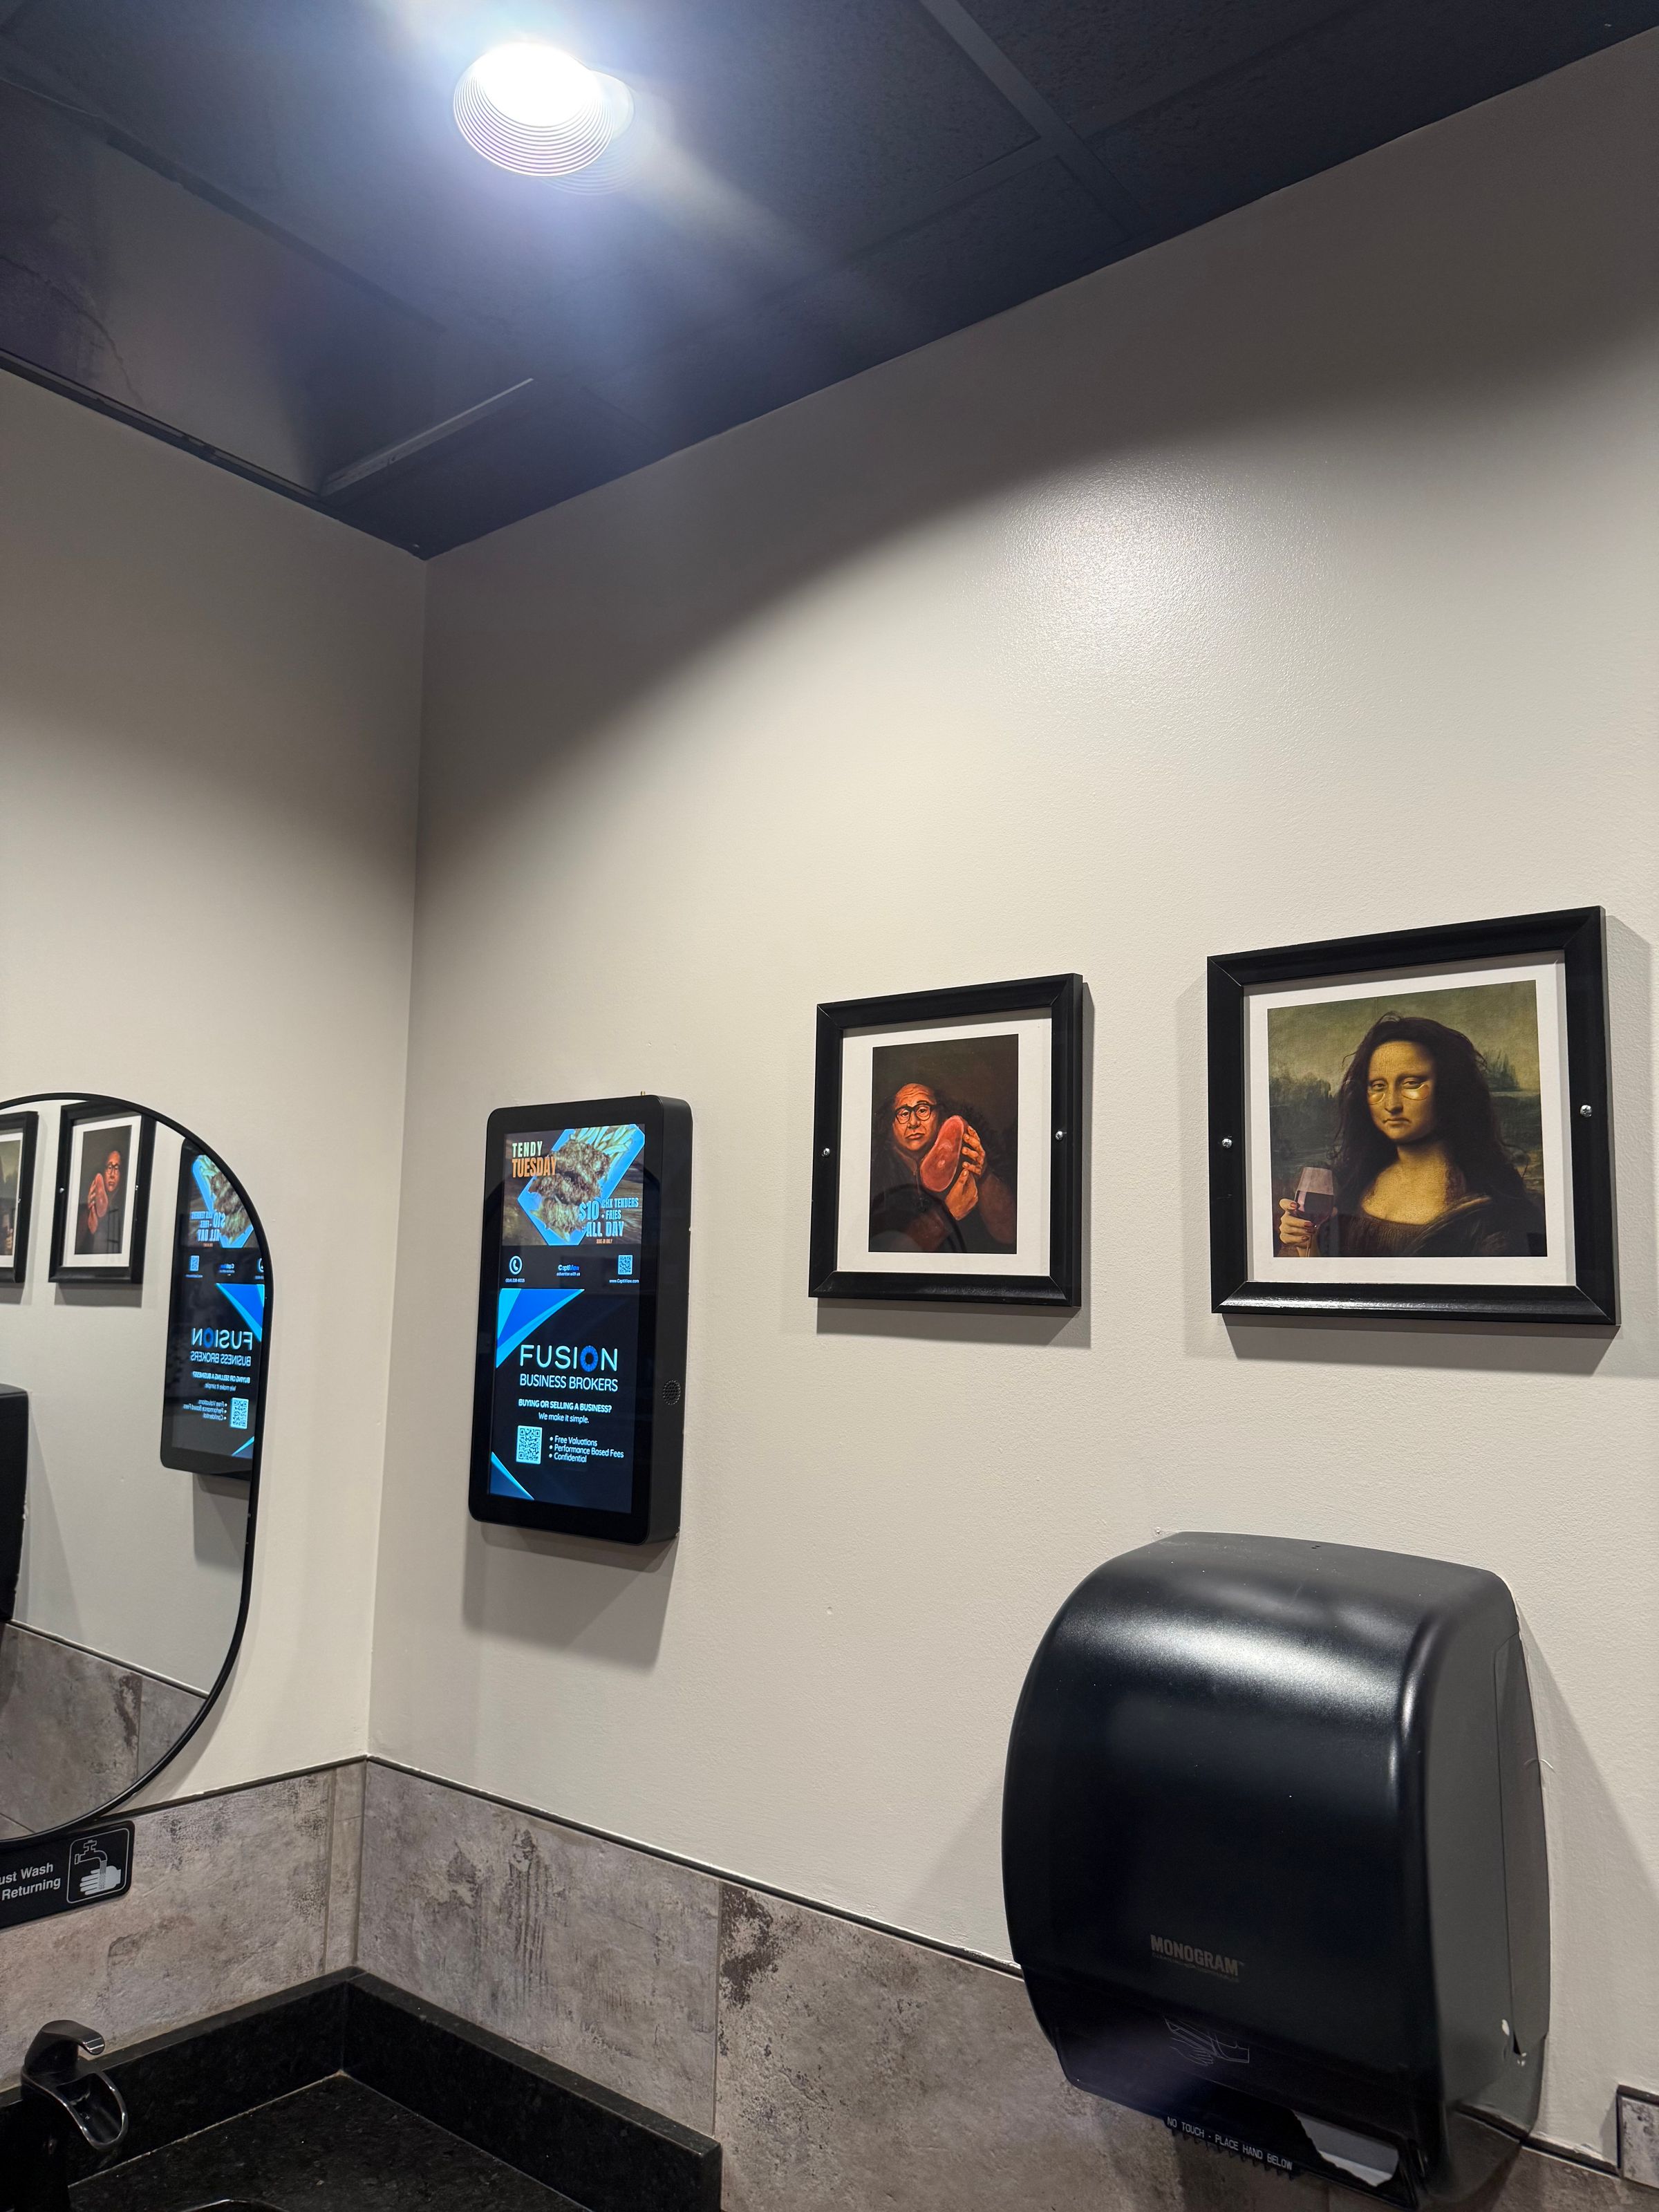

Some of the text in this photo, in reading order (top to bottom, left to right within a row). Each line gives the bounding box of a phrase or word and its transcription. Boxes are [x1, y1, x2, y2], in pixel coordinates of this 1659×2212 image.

[512, 1141, 543, 1158] TENDY
[512, 1156, 557, 1178] TUESDAY
[579, 1201, 599, 1221] $10
[615, 1197, 639, 1208] TENDERS
[606, 1210, 621, 1219] FRIES
[586, 1221, 624, 1237] ALL DAY
[520, 1344, 618, 1371] FUSION
[520, 1374, 618, 1392] BUSINESS BROKERS
[518, 1399, 539, 1407] BUYING
[550, 1401, 573, 1410] SELLING
[580, 1403, 612, 1413] BUSINESS?
[549, 1413, 564, 1421] make
[570, 1415, 589, 1424] simple.
[554, 1435, 597, 1446] Free Valuations
[554, 1443, 624, 1458] Performance Based Fees
[554, 1452, 587, 1463] Confidential
[0, 1862, 53, 1885] ust Wash
[1, 1877, 61, 1900] Returning
[1150, 1934, 1238, 1976] MONOGRAM
[1167, 2117, 1177, 2128] NO
[1181, 2122, 1204, 2138] TOUCH
[1215, 2135, 1239, 2150] PLACE
[1242, 2144, 1263, 2159] HAND
[1267, 2154, 1293, 2171] BELOW
